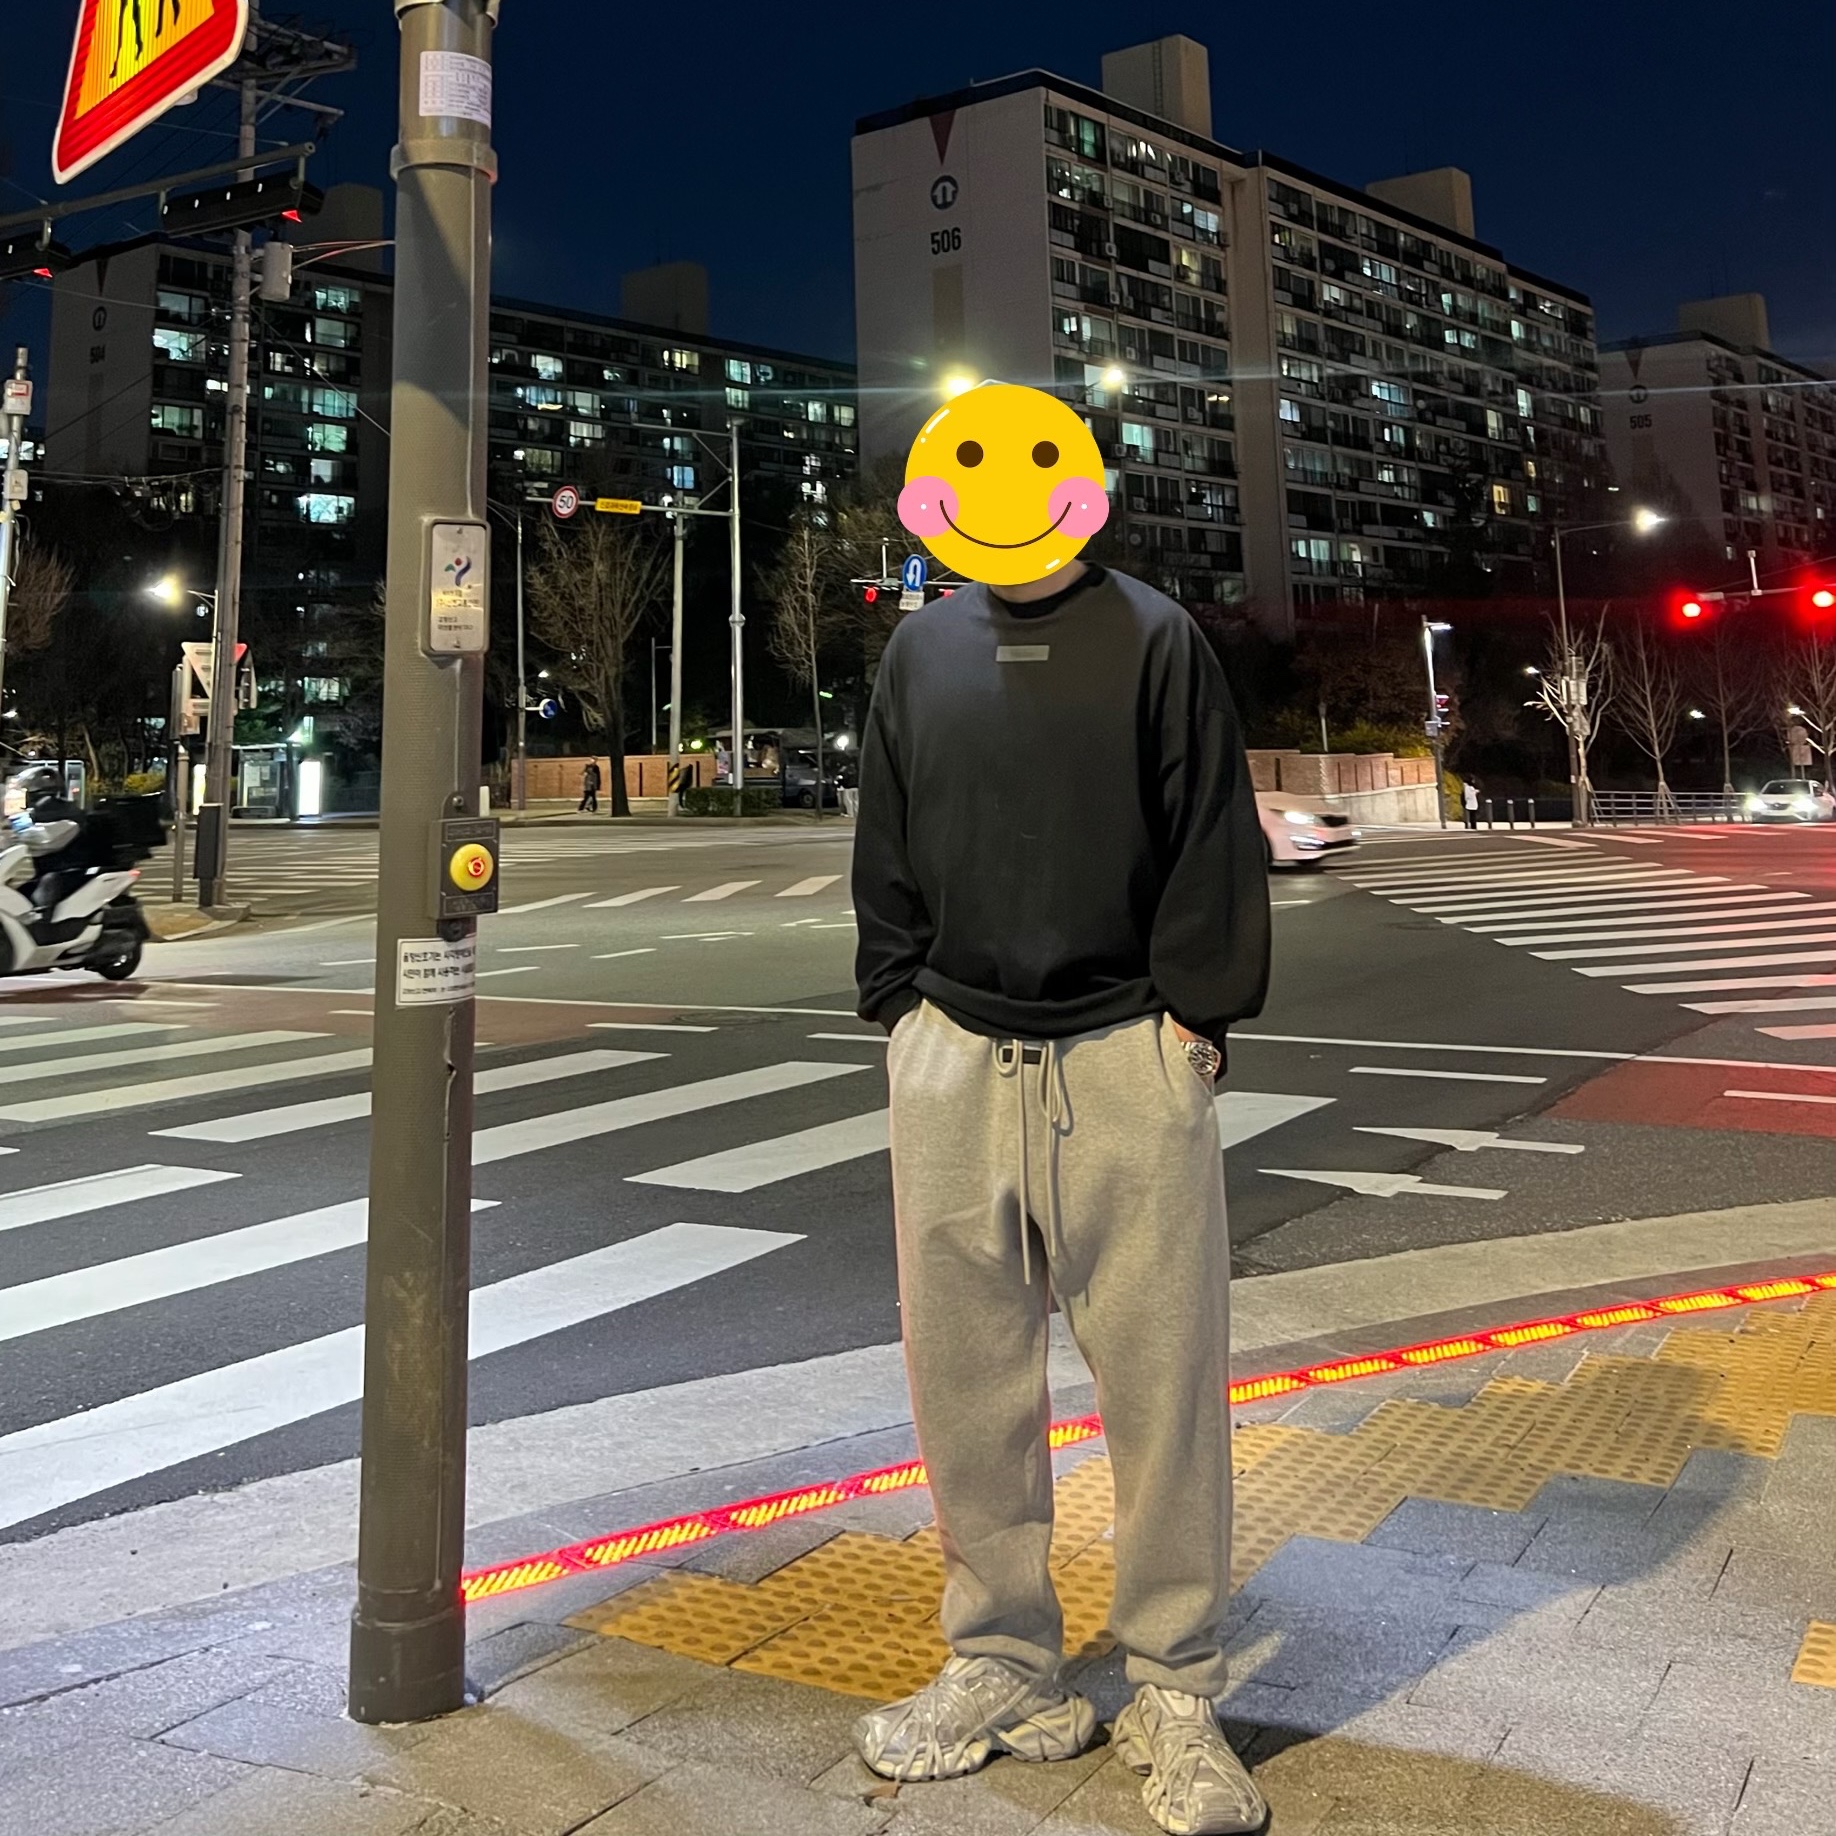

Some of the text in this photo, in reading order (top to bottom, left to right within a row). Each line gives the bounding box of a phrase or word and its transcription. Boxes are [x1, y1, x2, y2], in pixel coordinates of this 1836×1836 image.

[930, 226, 962, 255] 506
[1630, 414, 1652, 429] 505
[557, 495, 574, 509] 50
